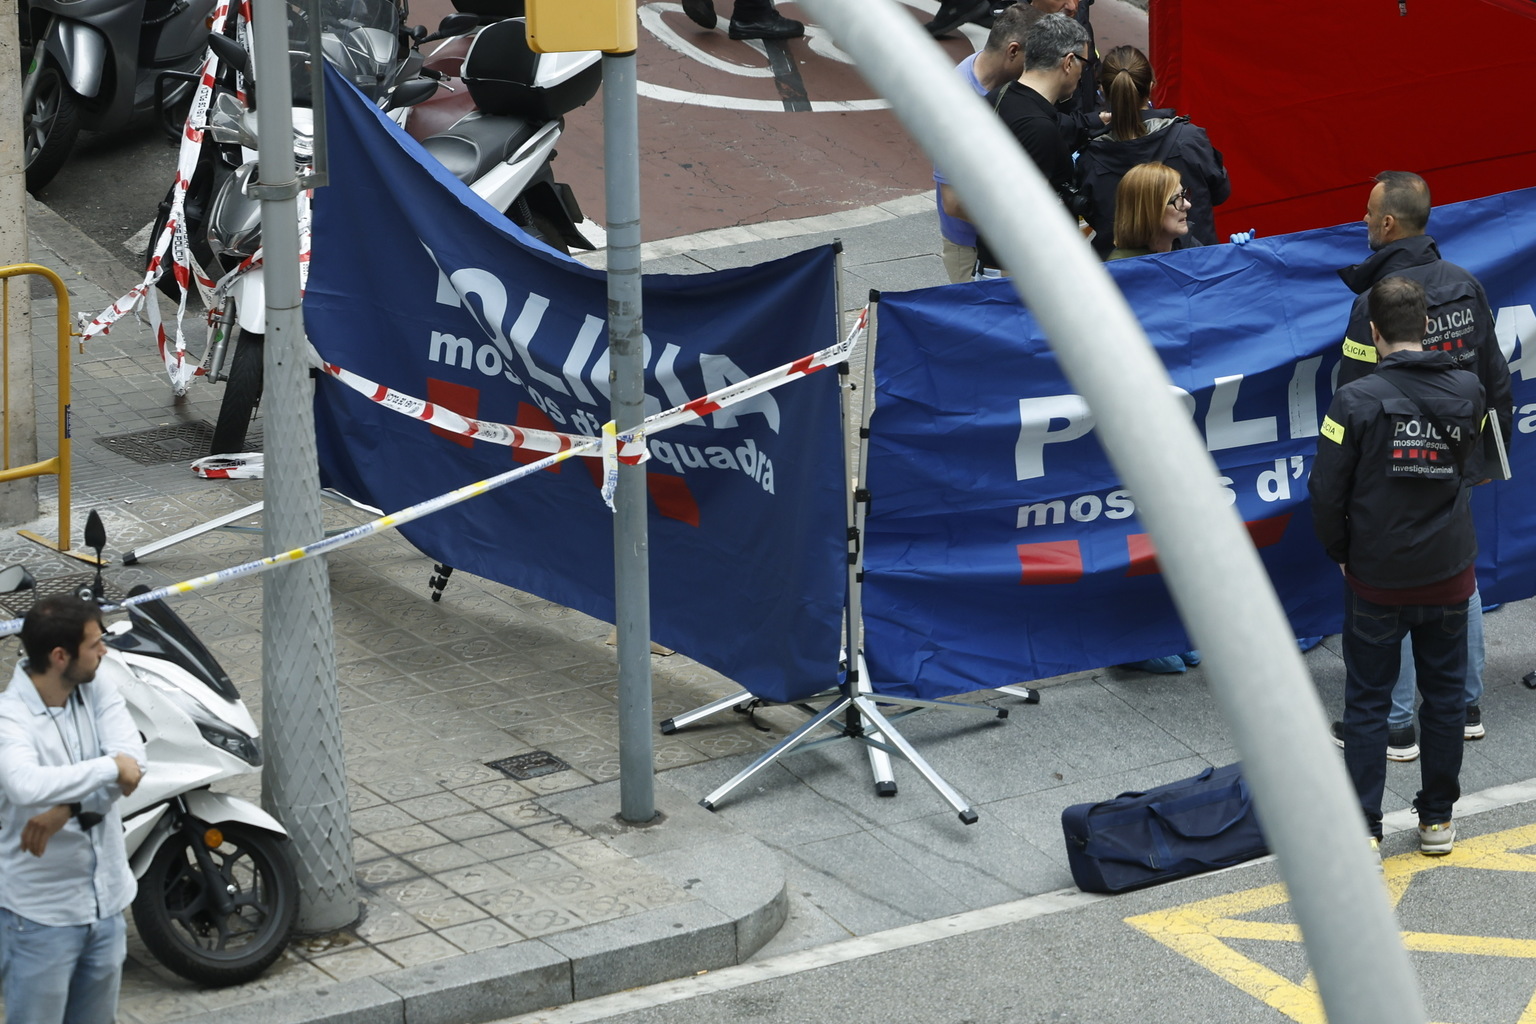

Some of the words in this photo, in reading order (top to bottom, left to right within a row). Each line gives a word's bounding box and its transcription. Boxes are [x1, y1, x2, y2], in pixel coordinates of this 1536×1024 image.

[174, 235, 184, 262] POLICIA
[1426, 308, 1474, 334] OLICIA
[1344, 343, 1367, 357] OLICIA
[1422, 335, 1443, 346] ossos
